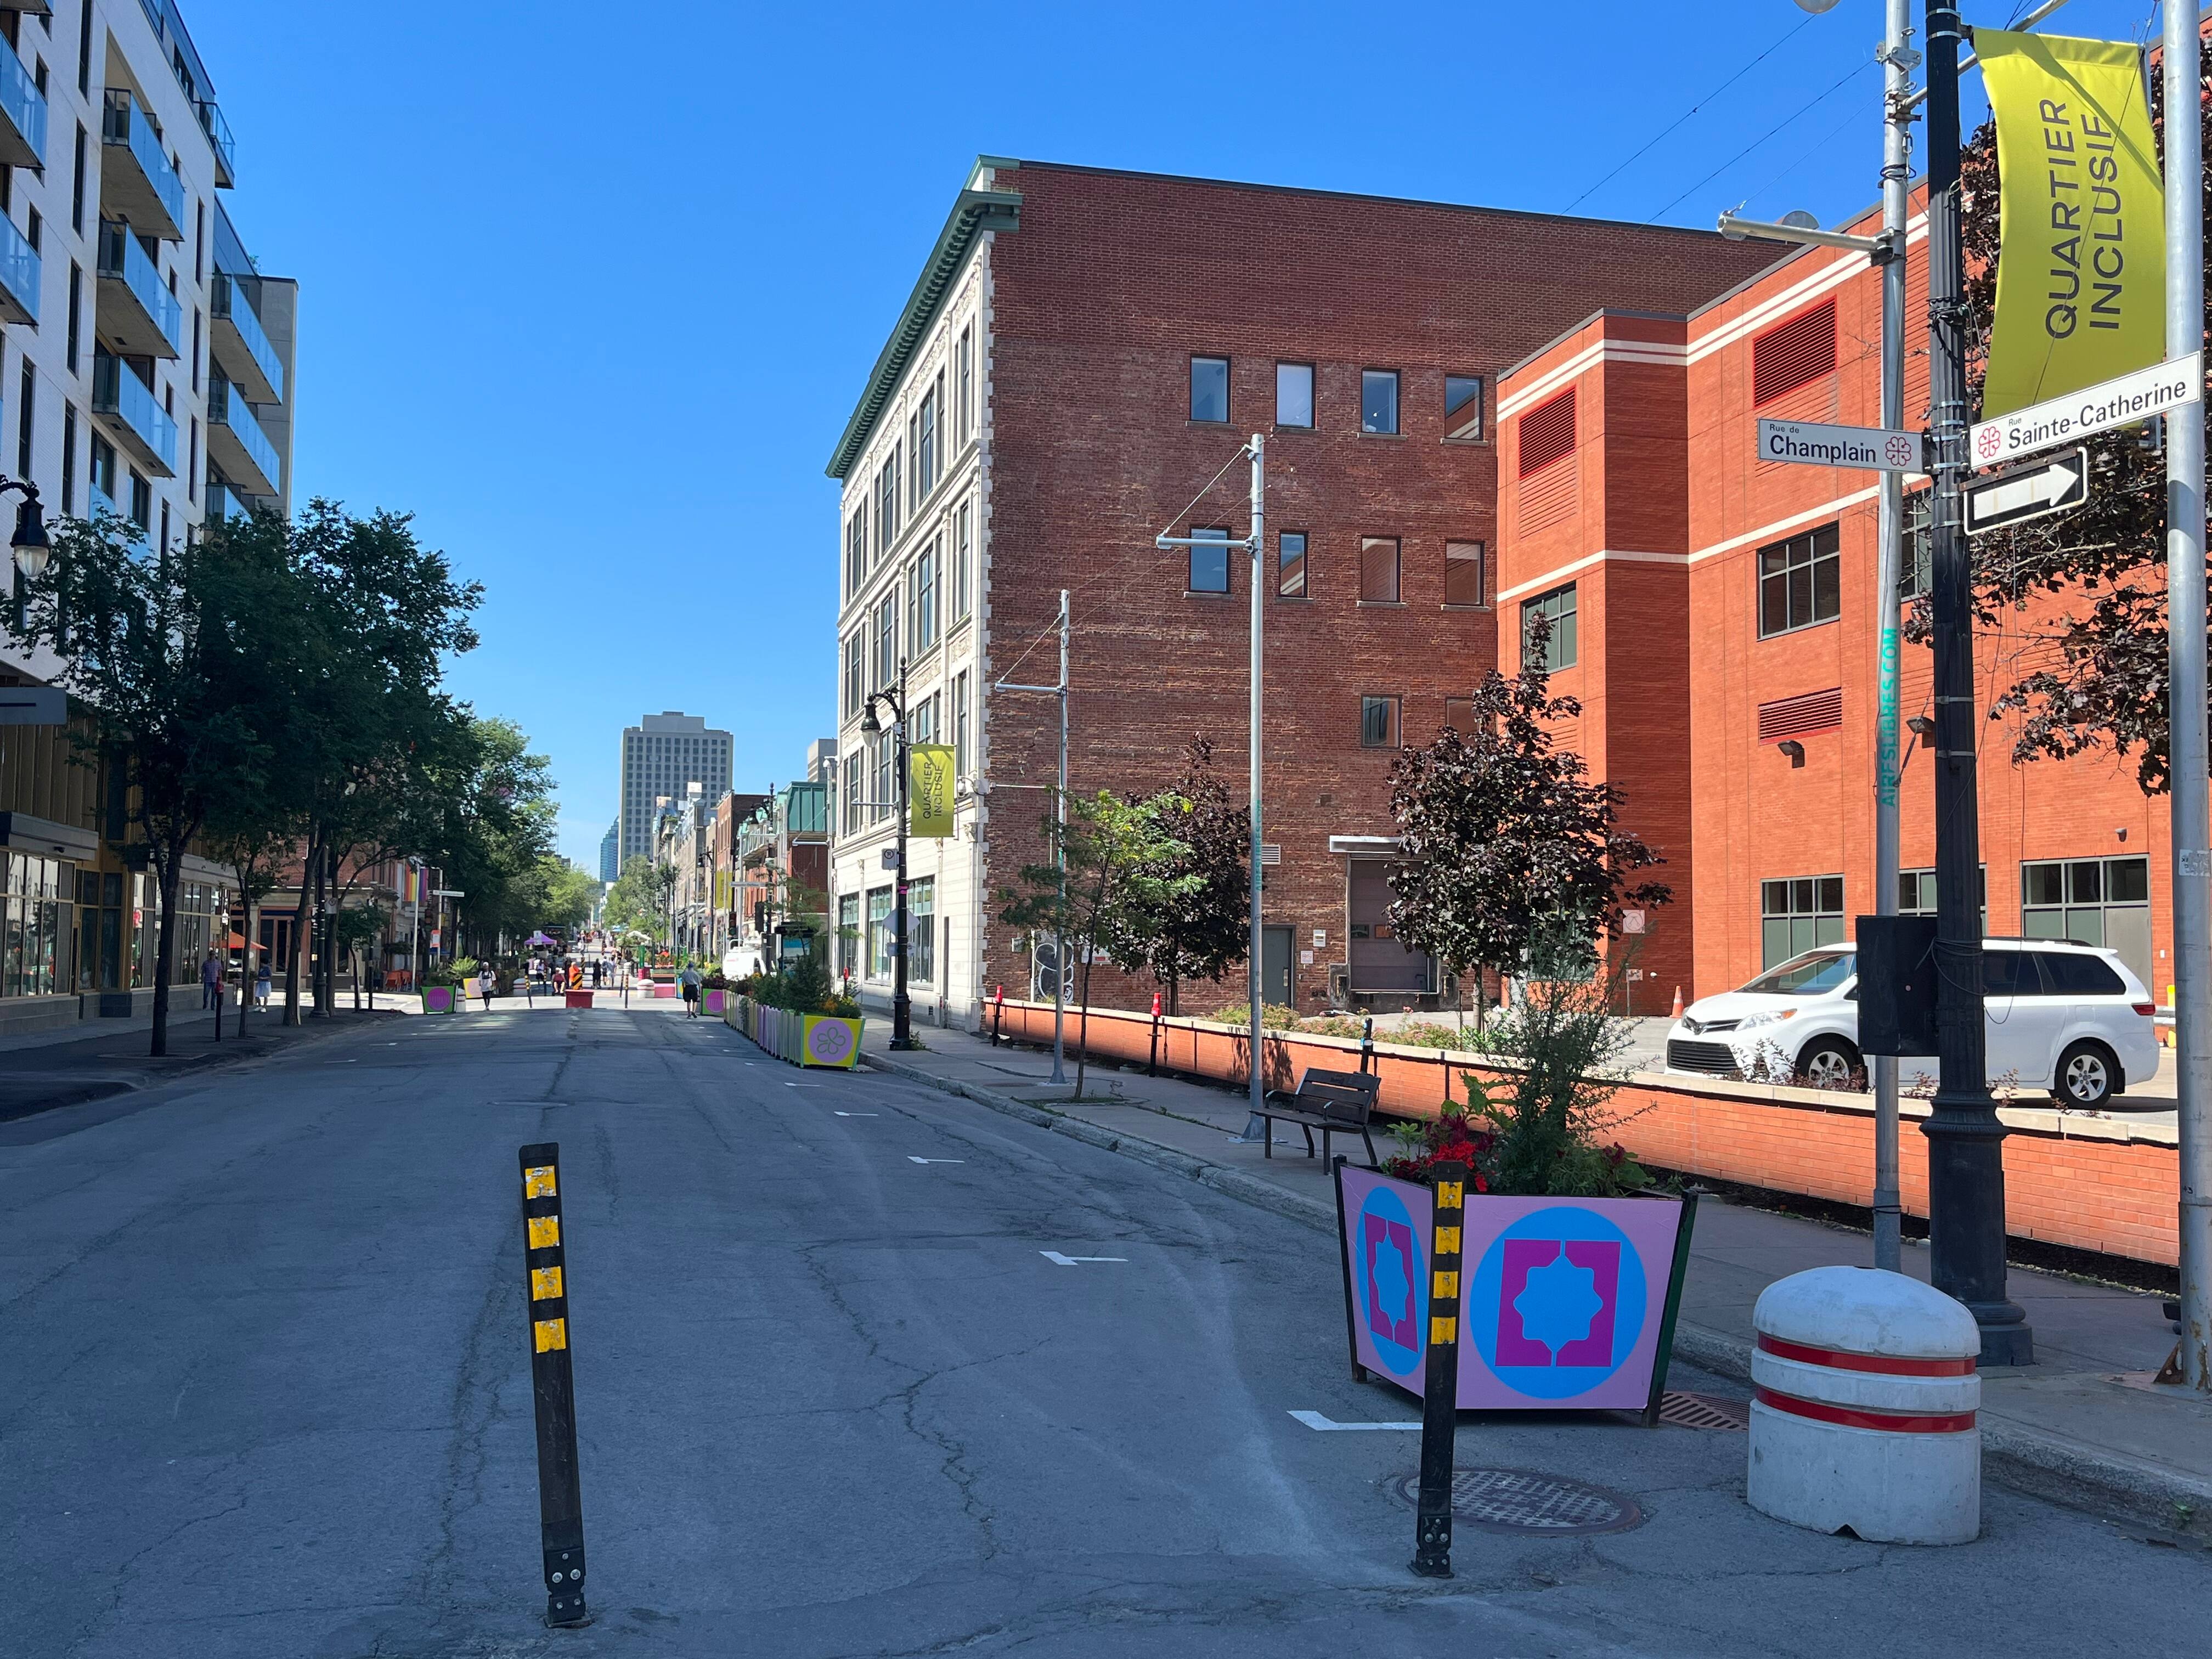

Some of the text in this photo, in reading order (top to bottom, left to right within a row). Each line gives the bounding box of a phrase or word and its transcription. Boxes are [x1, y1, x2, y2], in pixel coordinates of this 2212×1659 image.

[2039, 99, 2081, 339] QUARTIER
[2080, 114, 2123, 329] INCLUSIF
[1769, 424, 1800, 434] Rue de
[2008, 381, 2186, 450] Sainte-Catherine
[2008, 417, 2022, 427] Rue
[1770, 434, 1877, 464] Champlain
[923, 761, 932, 819] QUARTIER
[934, 765, 943, 817] INCLUSIF
